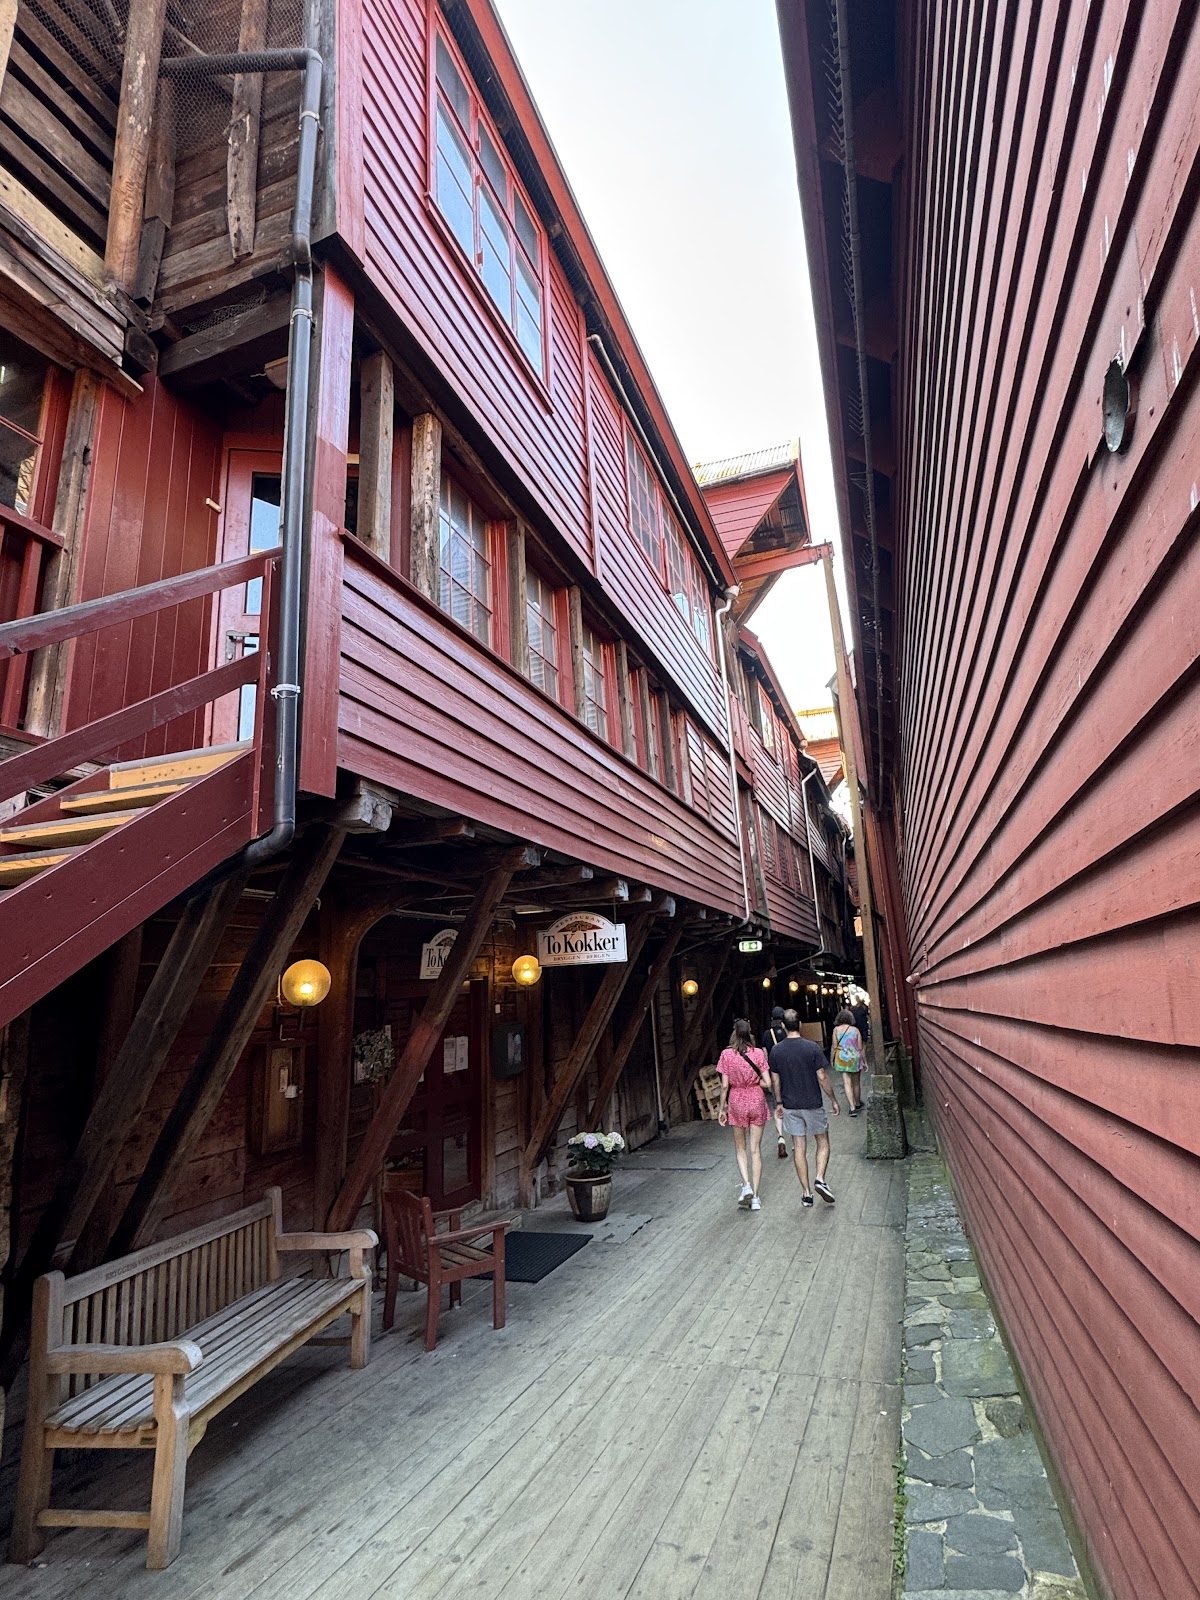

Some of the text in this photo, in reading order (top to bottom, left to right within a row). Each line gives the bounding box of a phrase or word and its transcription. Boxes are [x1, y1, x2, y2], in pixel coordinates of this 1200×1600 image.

[555, 915, 606, 928] RESTAURANT
[543, 932, 619, 955] To Kokker
[426, 948, 436, 967] To
